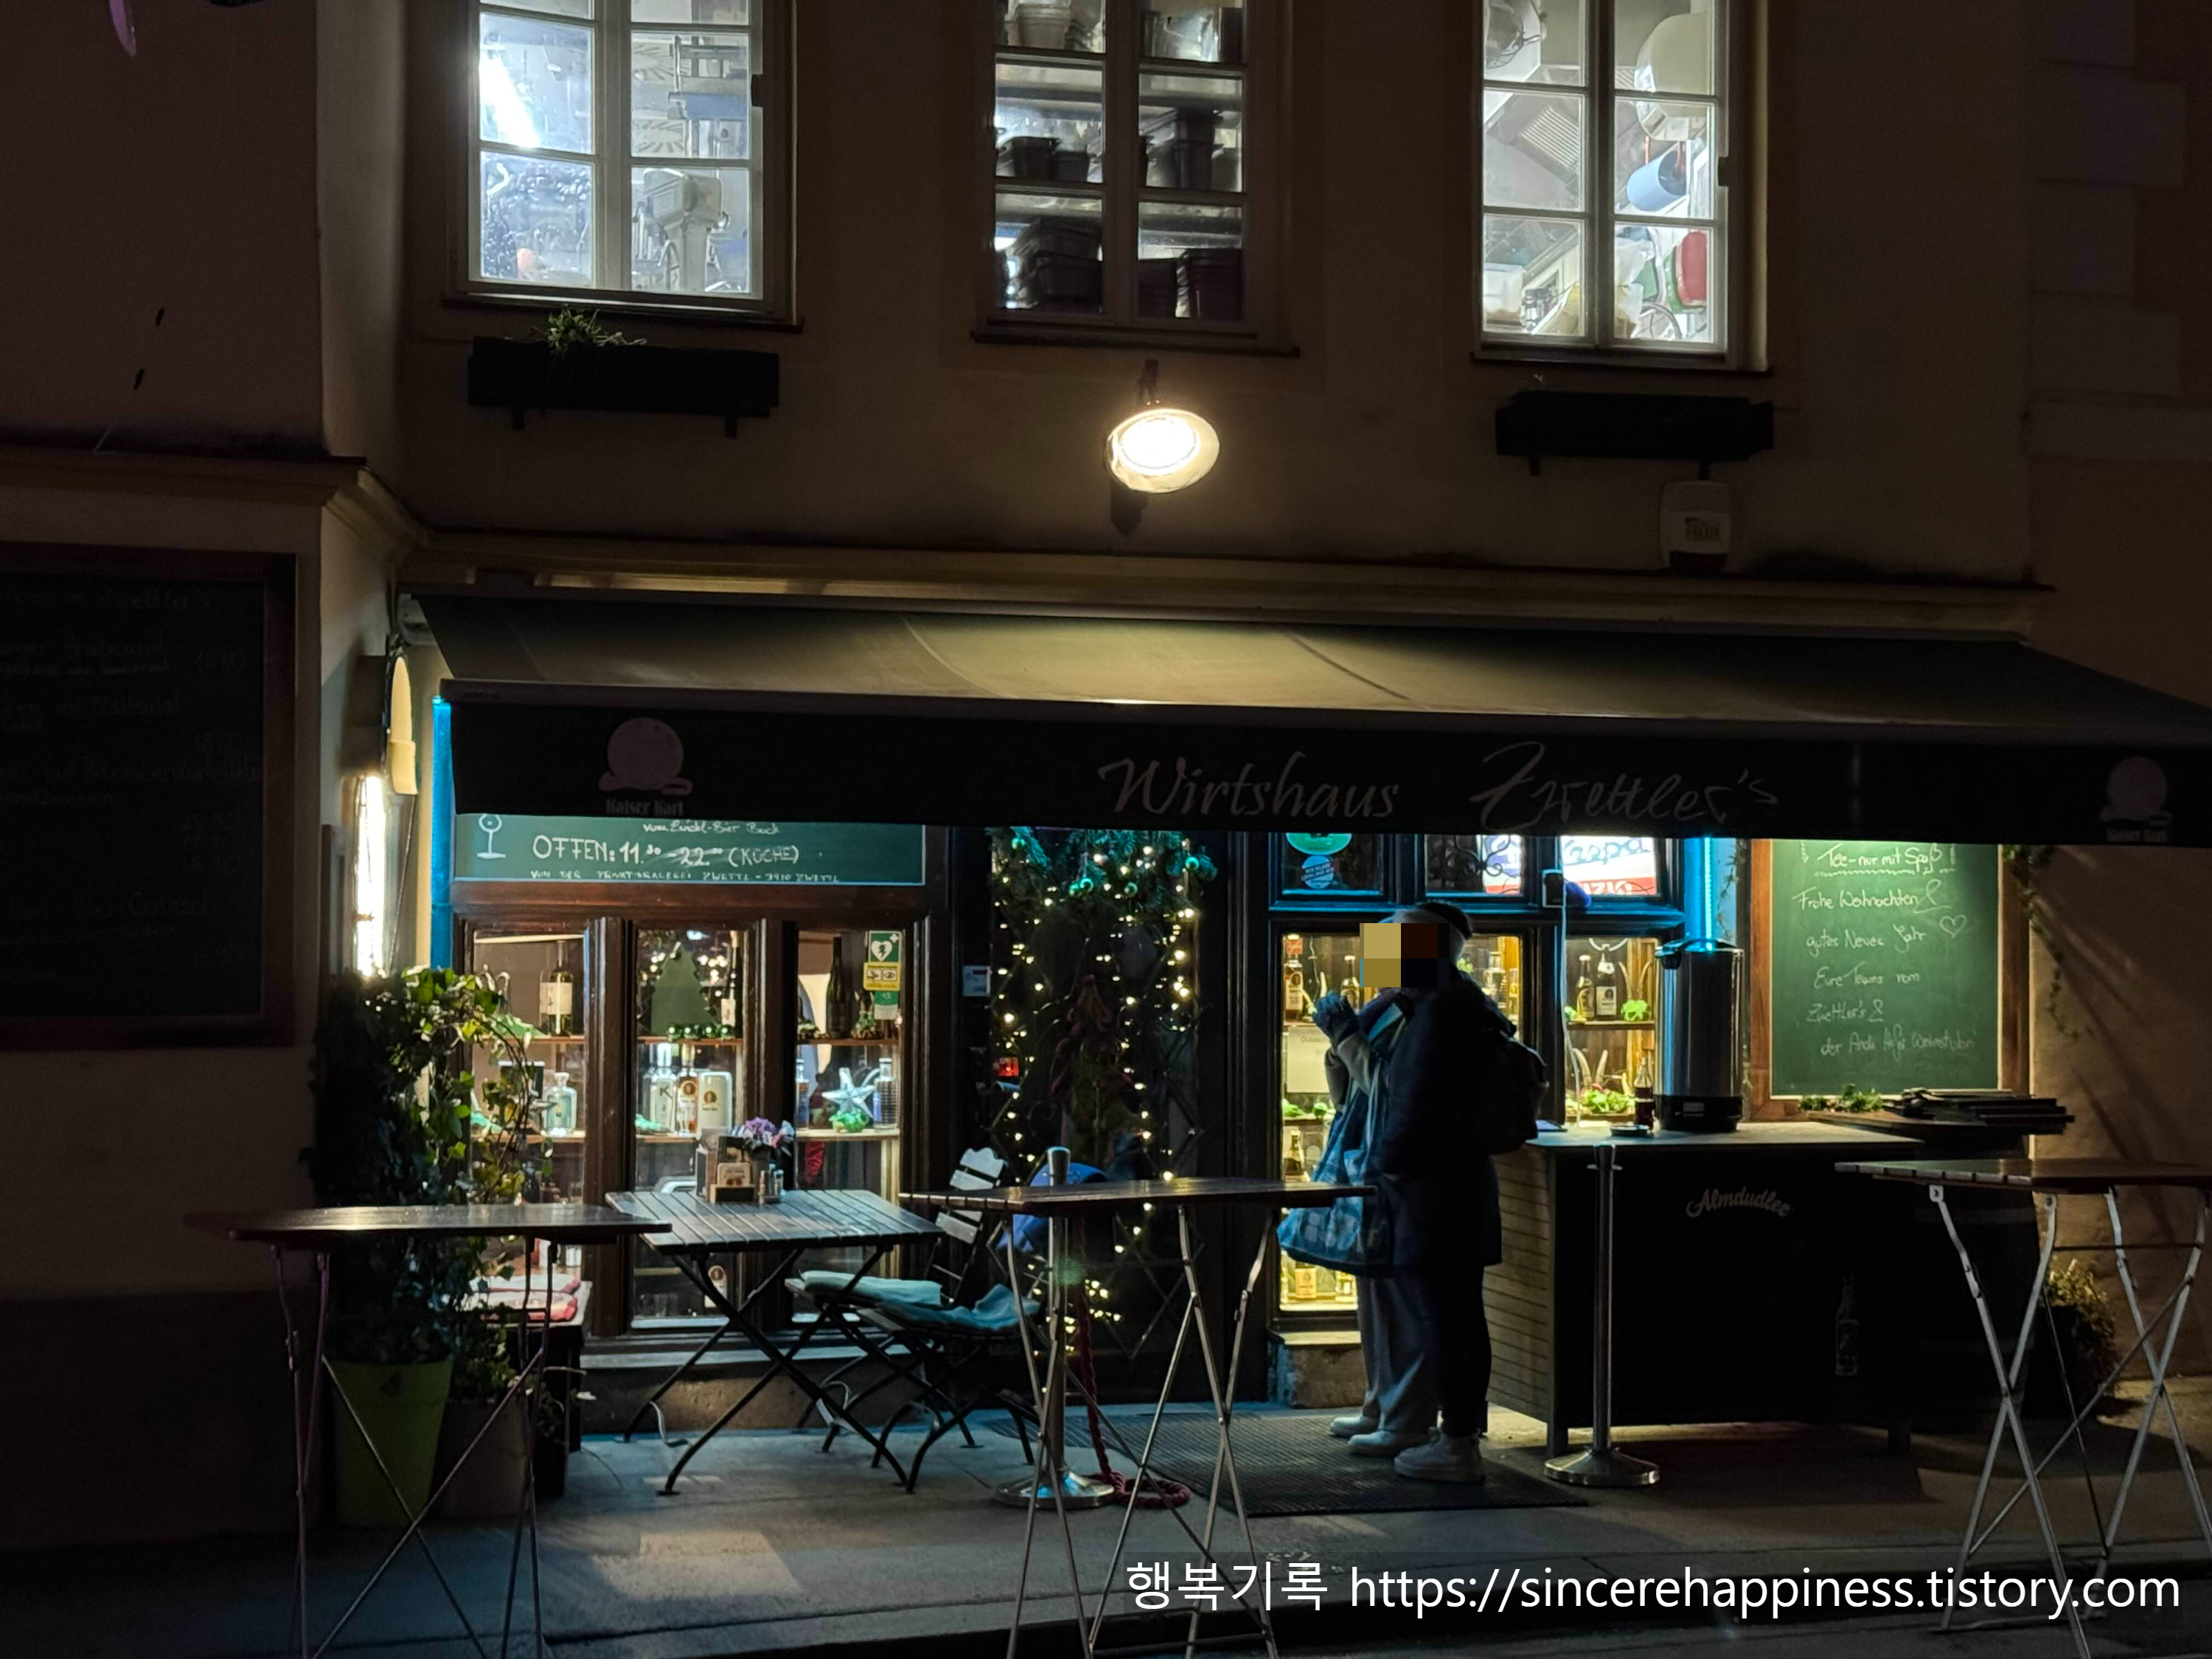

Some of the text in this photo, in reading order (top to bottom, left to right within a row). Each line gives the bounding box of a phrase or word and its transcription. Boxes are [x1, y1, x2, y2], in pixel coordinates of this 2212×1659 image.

[1097, 741, 1778, 832] Wirtshaus Zwettler's
[1882, 846, 1901, 866] mit
[1792, 887, 1834, 910] Frohe
